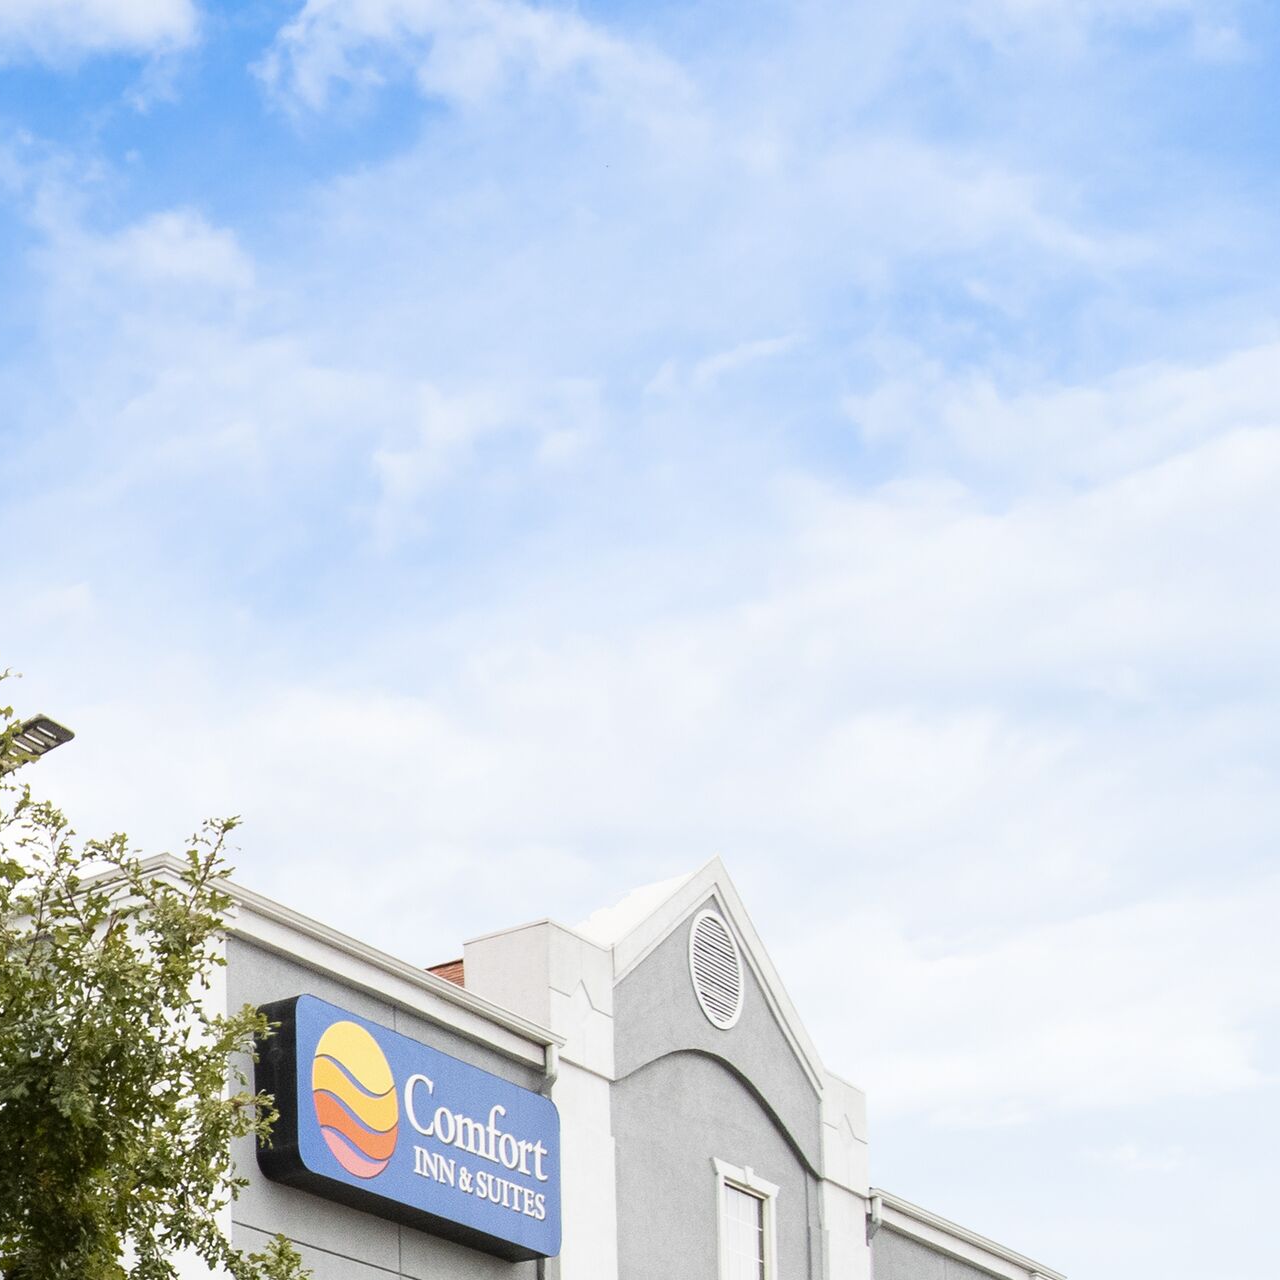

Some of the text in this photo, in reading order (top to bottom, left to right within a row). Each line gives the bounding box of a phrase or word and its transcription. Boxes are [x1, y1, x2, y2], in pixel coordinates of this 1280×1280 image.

[404, 1073, 548, 1181] Comfort
[413, 1145, 546, 1221] INN & SUITES
